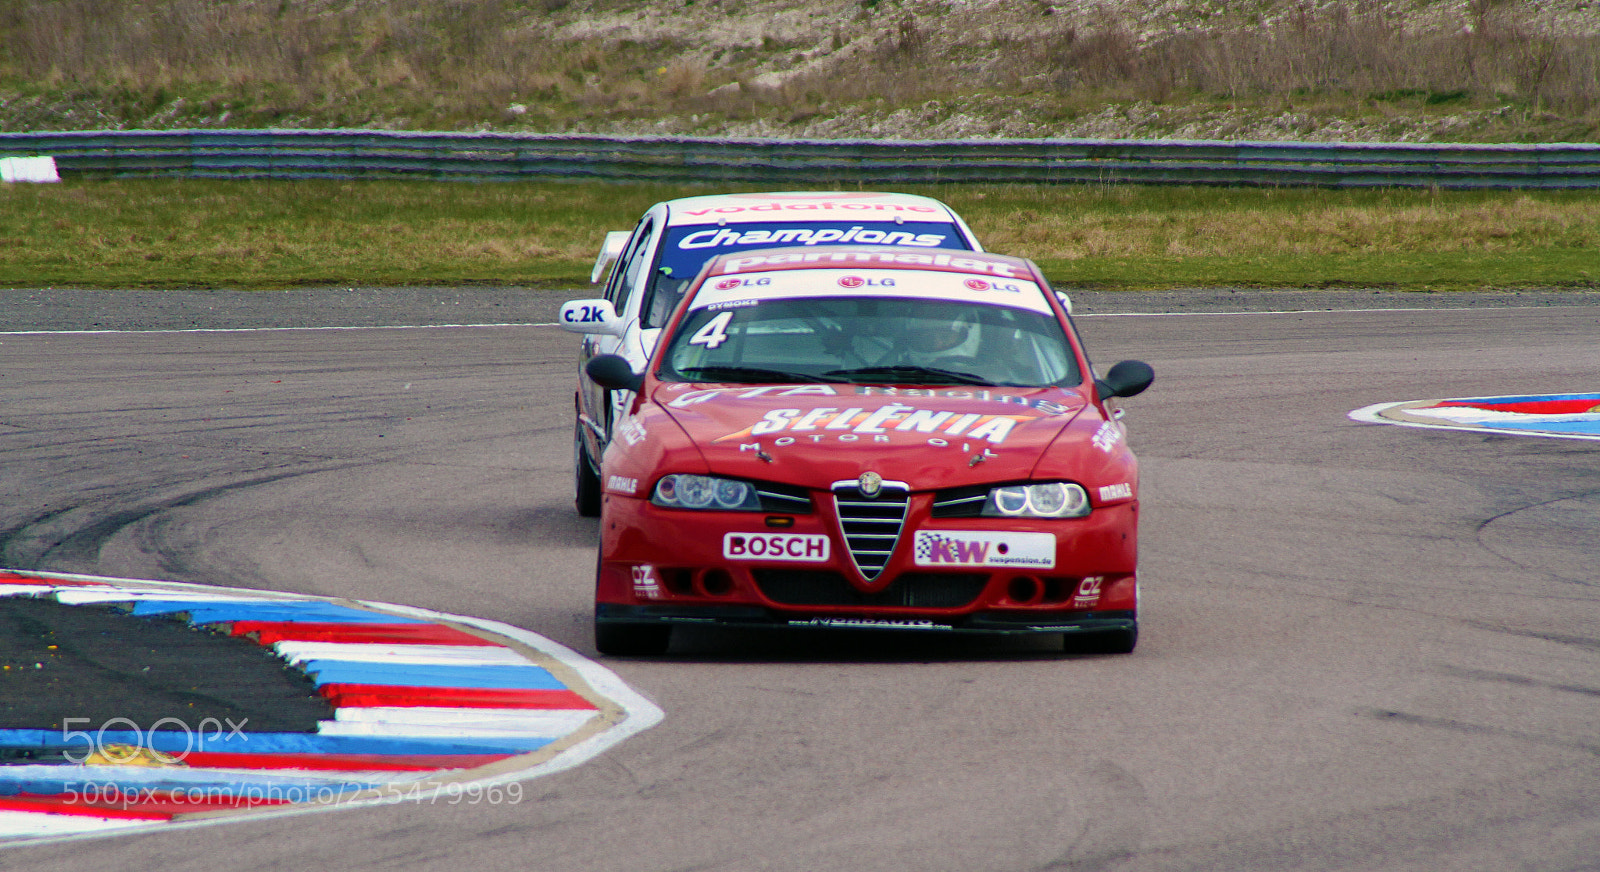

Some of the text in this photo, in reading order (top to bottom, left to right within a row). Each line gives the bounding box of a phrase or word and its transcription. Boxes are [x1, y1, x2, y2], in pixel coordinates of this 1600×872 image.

[682, 201, 937, 216] vodafone
[678, 226, 946, 249] Champions
[723, 251, 1017, 277] parmalat
[742, 277, 772, 287] LG
[866, 278, 896, 287] LG
[991, 282, 1021, 293] LG
[564, 305, 605, 323] c.2k
[688, 311, 734, 349] 4
[739, 434, 999, 458] MOTOR OIL
[607, 475, 638, 494] MAHLE
[1099, 482, 1133, 502] MAHLE
[728, 535, 825, 558] BOSCH
[930, 540, 991, 563] KW
[631, 565, 656, 585] OZ
[1079, 575, 1104, 596] OZ
